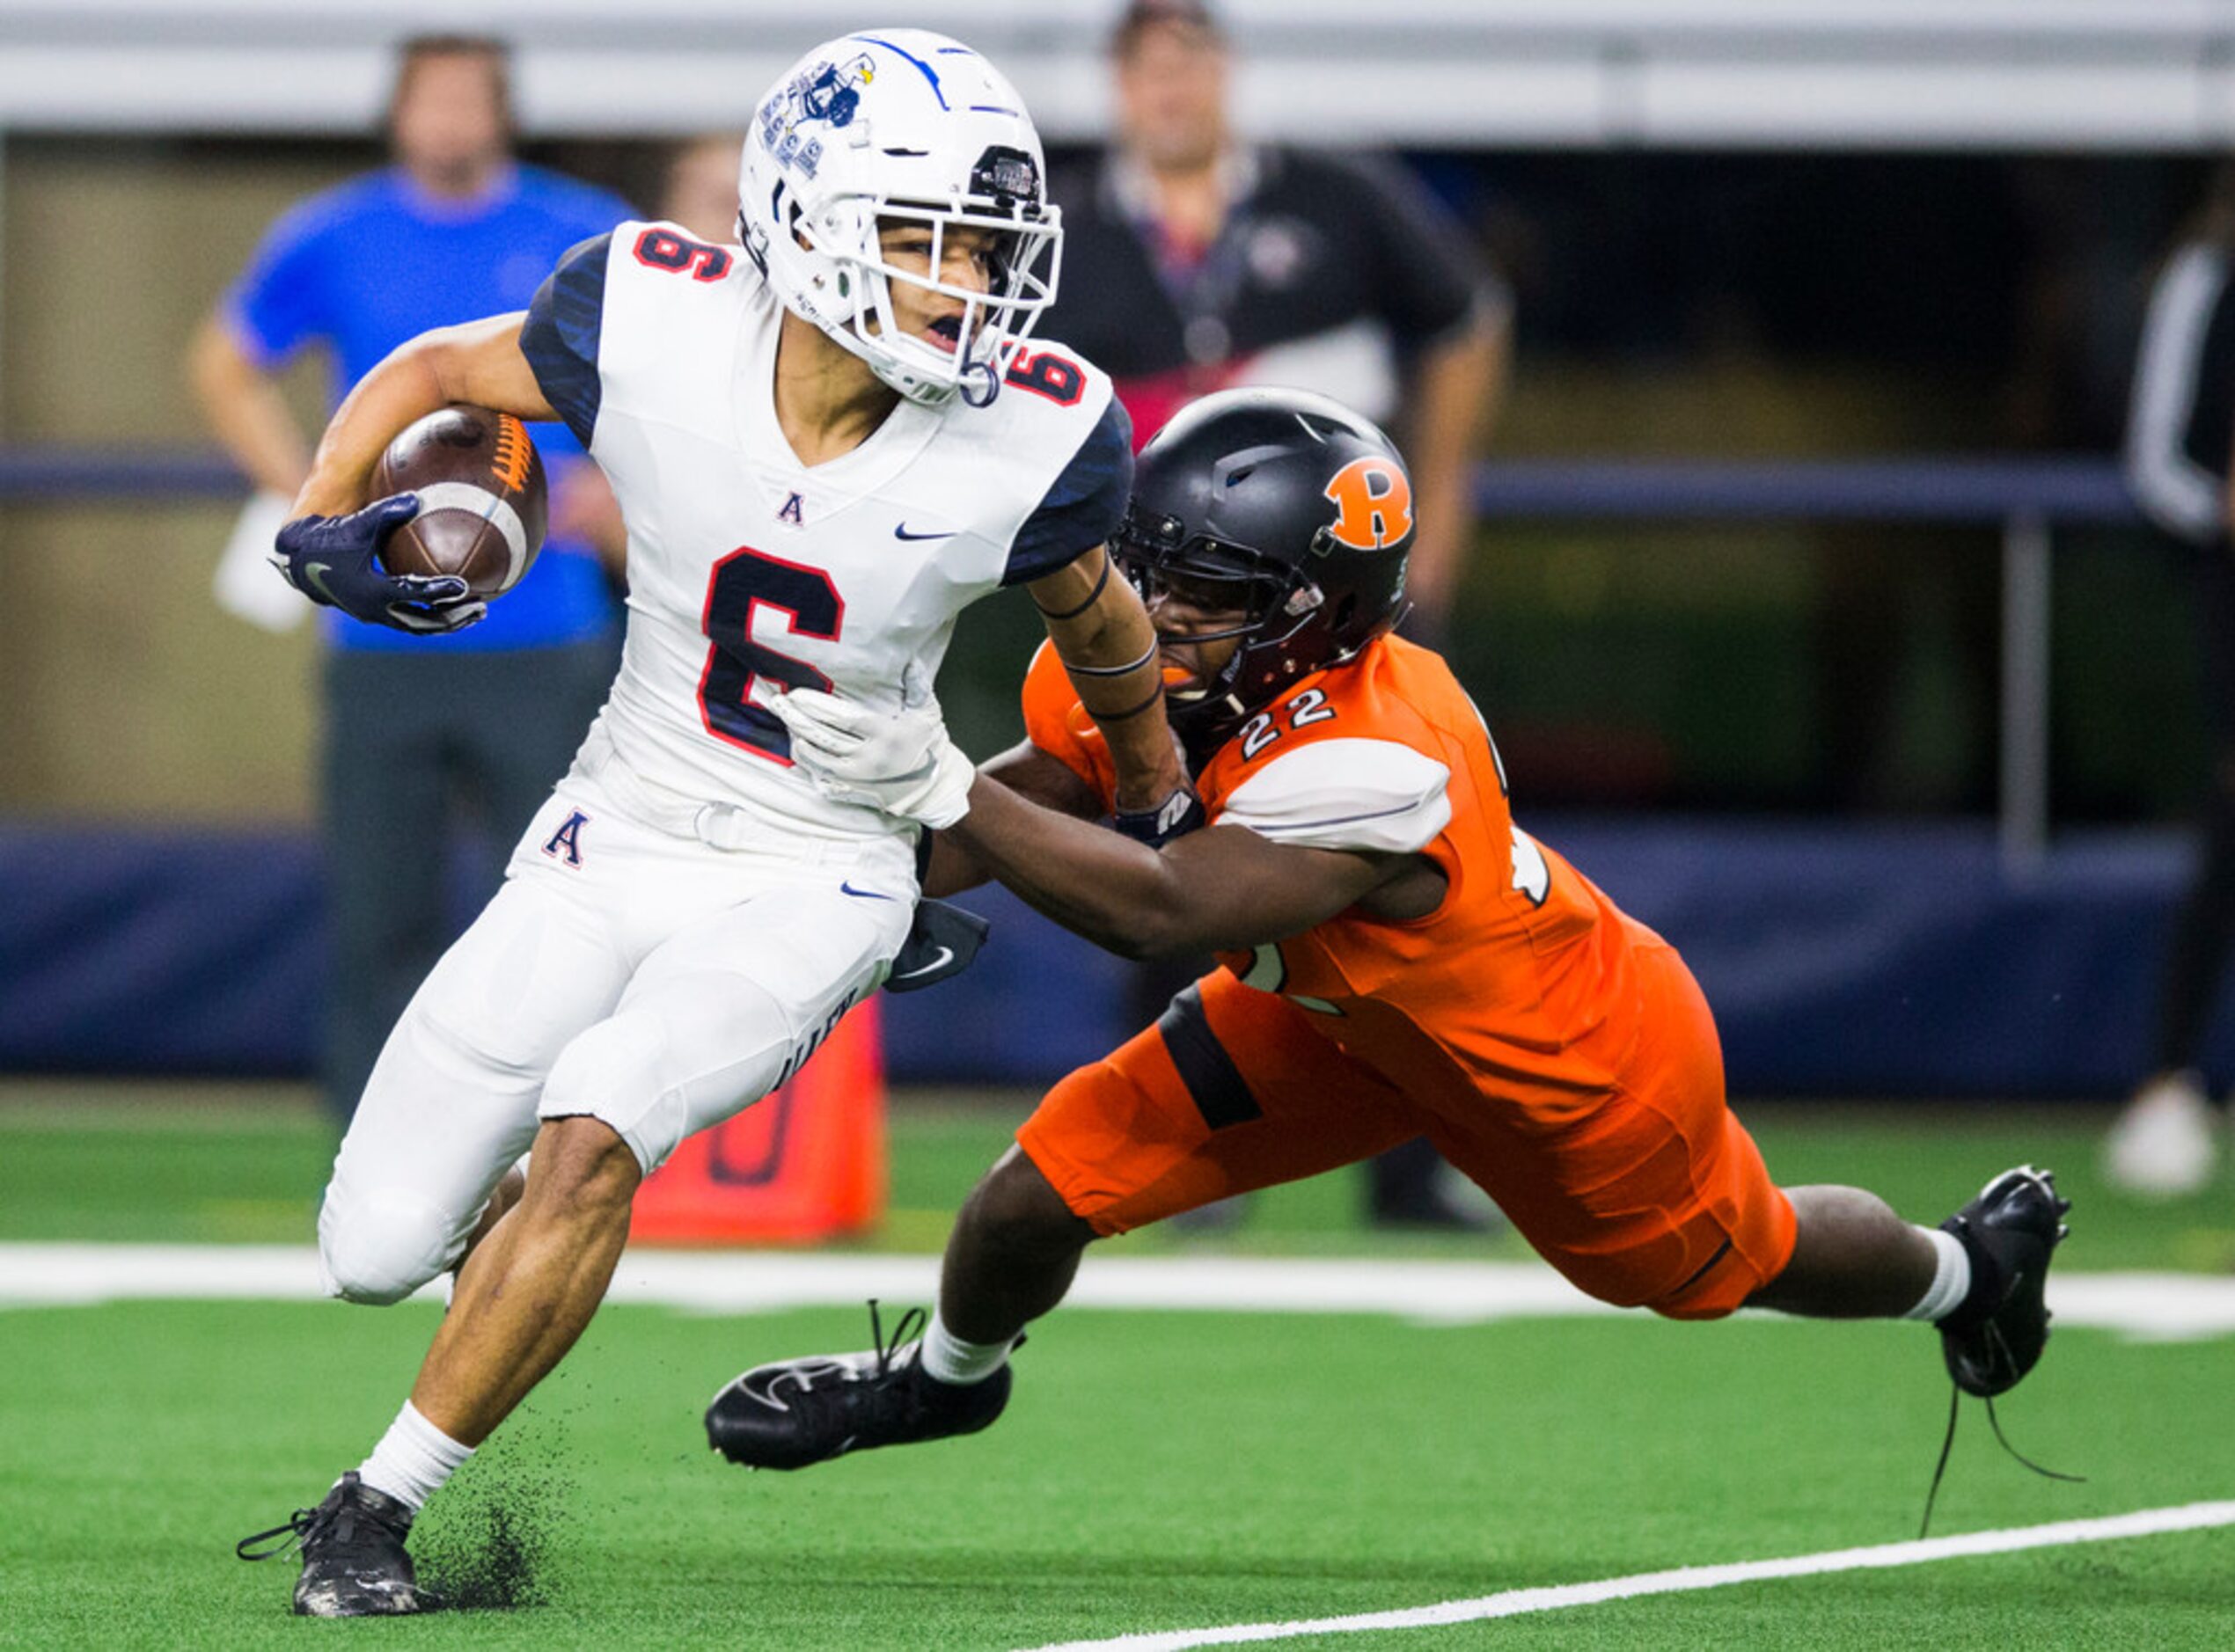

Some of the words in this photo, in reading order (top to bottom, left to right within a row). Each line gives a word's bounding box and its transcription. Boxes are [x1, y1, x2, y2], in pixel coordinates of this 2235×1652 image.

[777, 491, 804, 527] A
[1324, 457, 1413, 551] R
[697, 545, 846, 767] 6
[1235, 687, 1335, 762] 22
[539, 806, 593, 871] A
